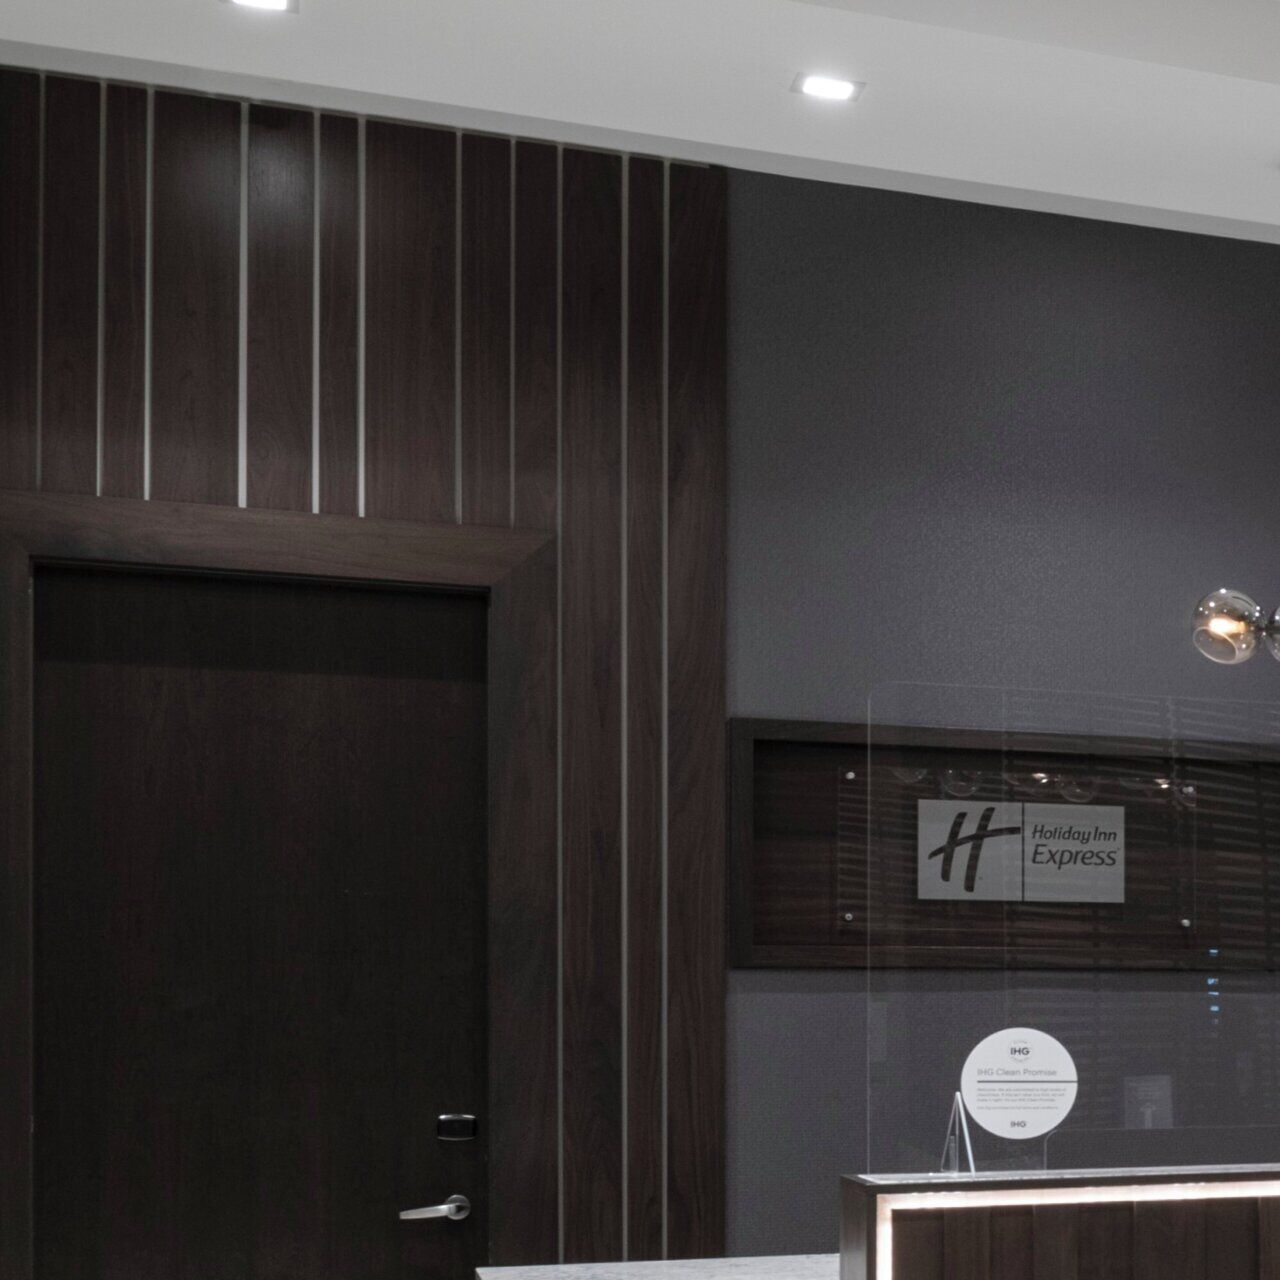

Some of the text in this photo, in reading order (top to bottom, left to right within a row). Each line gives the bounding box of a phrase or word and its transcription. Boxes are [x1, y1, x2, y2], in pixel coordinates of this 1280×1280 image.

[1032, 824, 1117, 845] Holiday Inn
[1032, 844, 1117, 870] Express
[1010, 1047, 1030, 1056] IHG
[977, 1067, 1057, 1076] IHG Clean Promise
[1010, 1120, 1027, 1128] IHG
